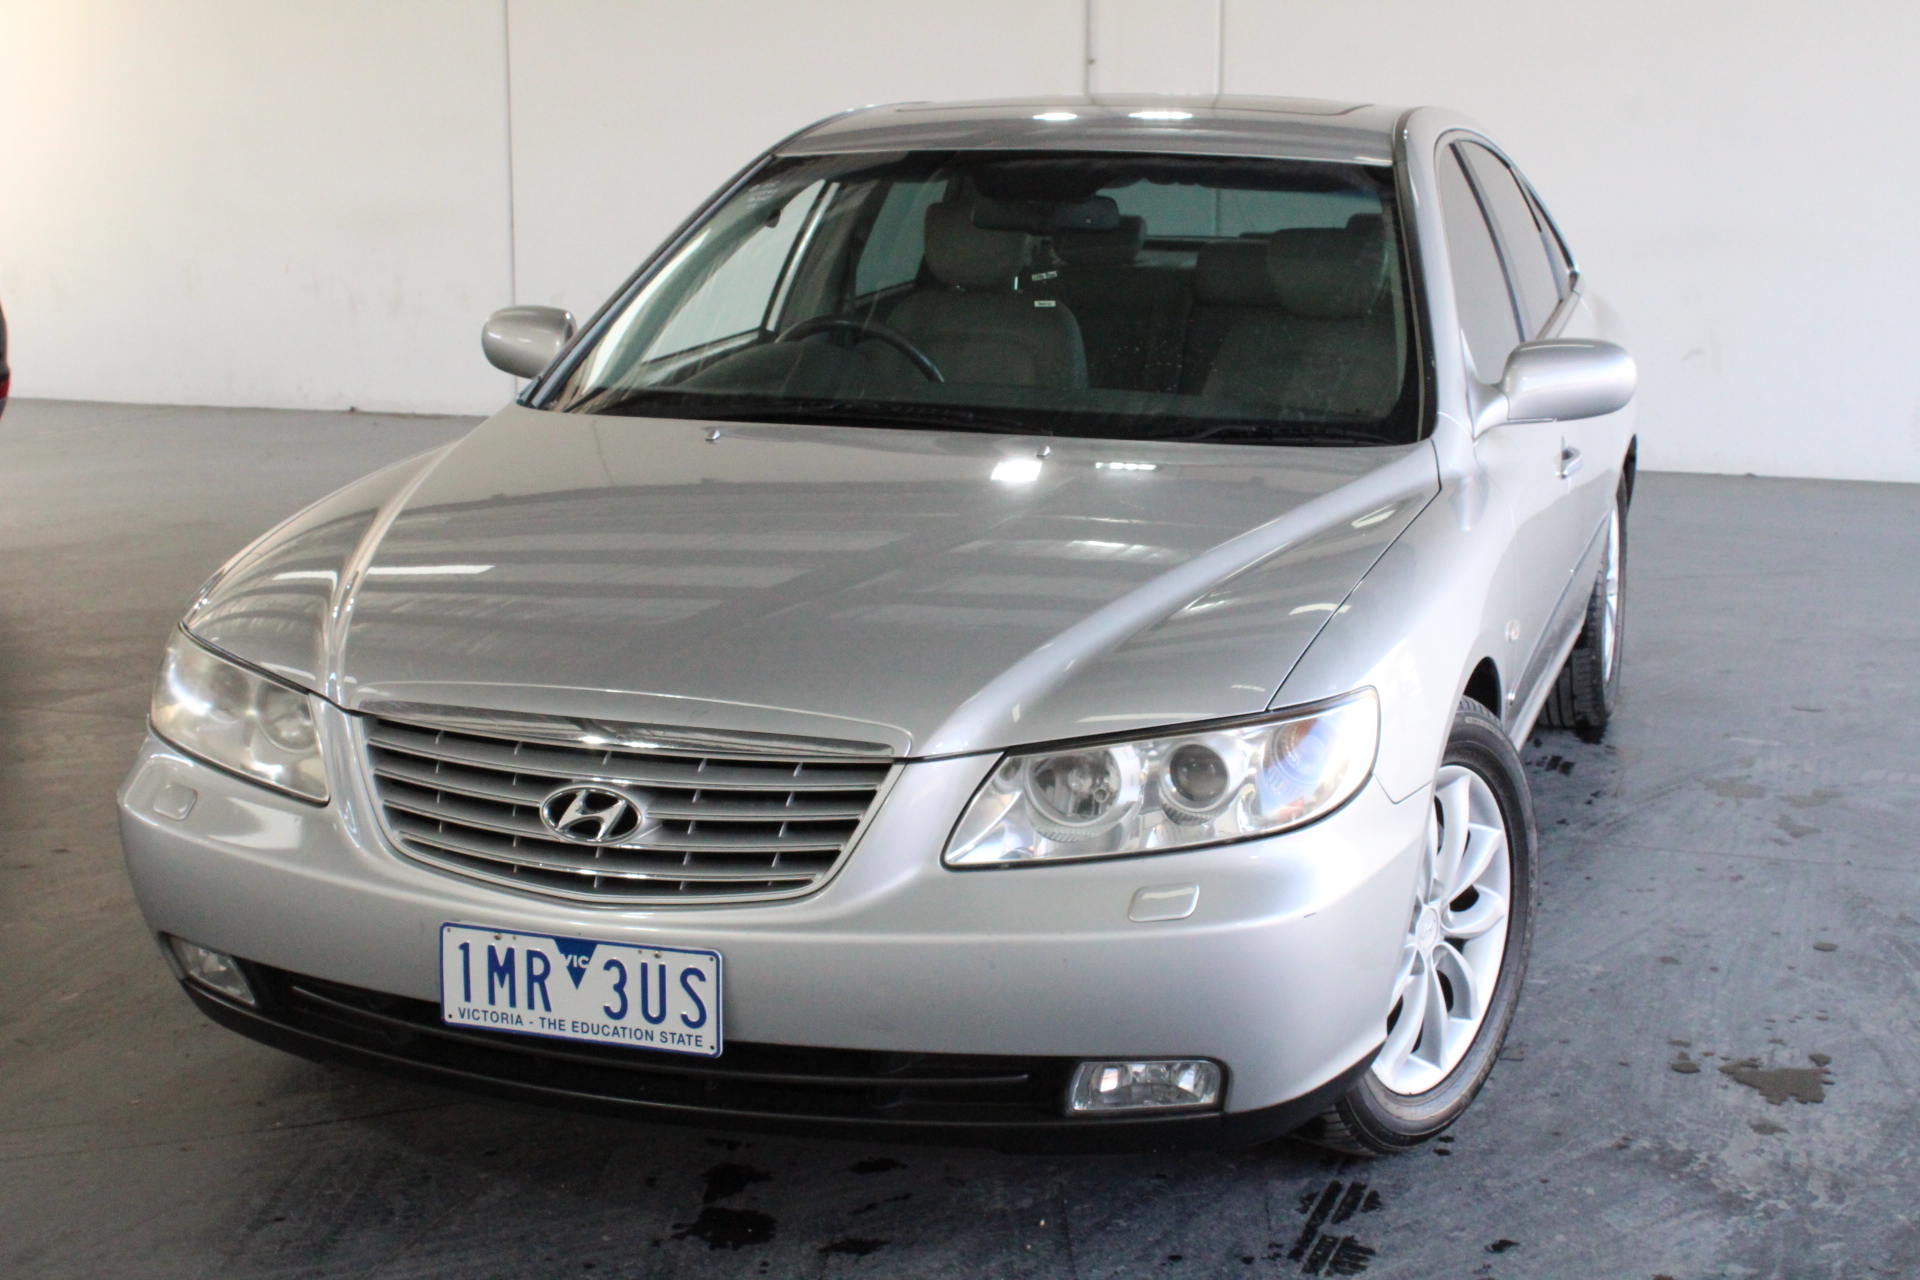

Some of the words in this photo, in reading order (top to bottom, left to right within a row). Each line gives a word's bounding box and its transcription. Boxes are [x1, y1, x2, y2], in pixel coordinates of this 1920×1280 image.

[565, 955, 589, 968] VIC
[459, 941, 551, 1012] 1MR
[603, 959, 707, 1029] 3US
[458, 1006, 524, 1026] VICTORIA
[538, 1017, 567, 1031] THE
[571, 1022, 654, 1042] EDUCATION
[659, 1032, 704, 1048] STATE
